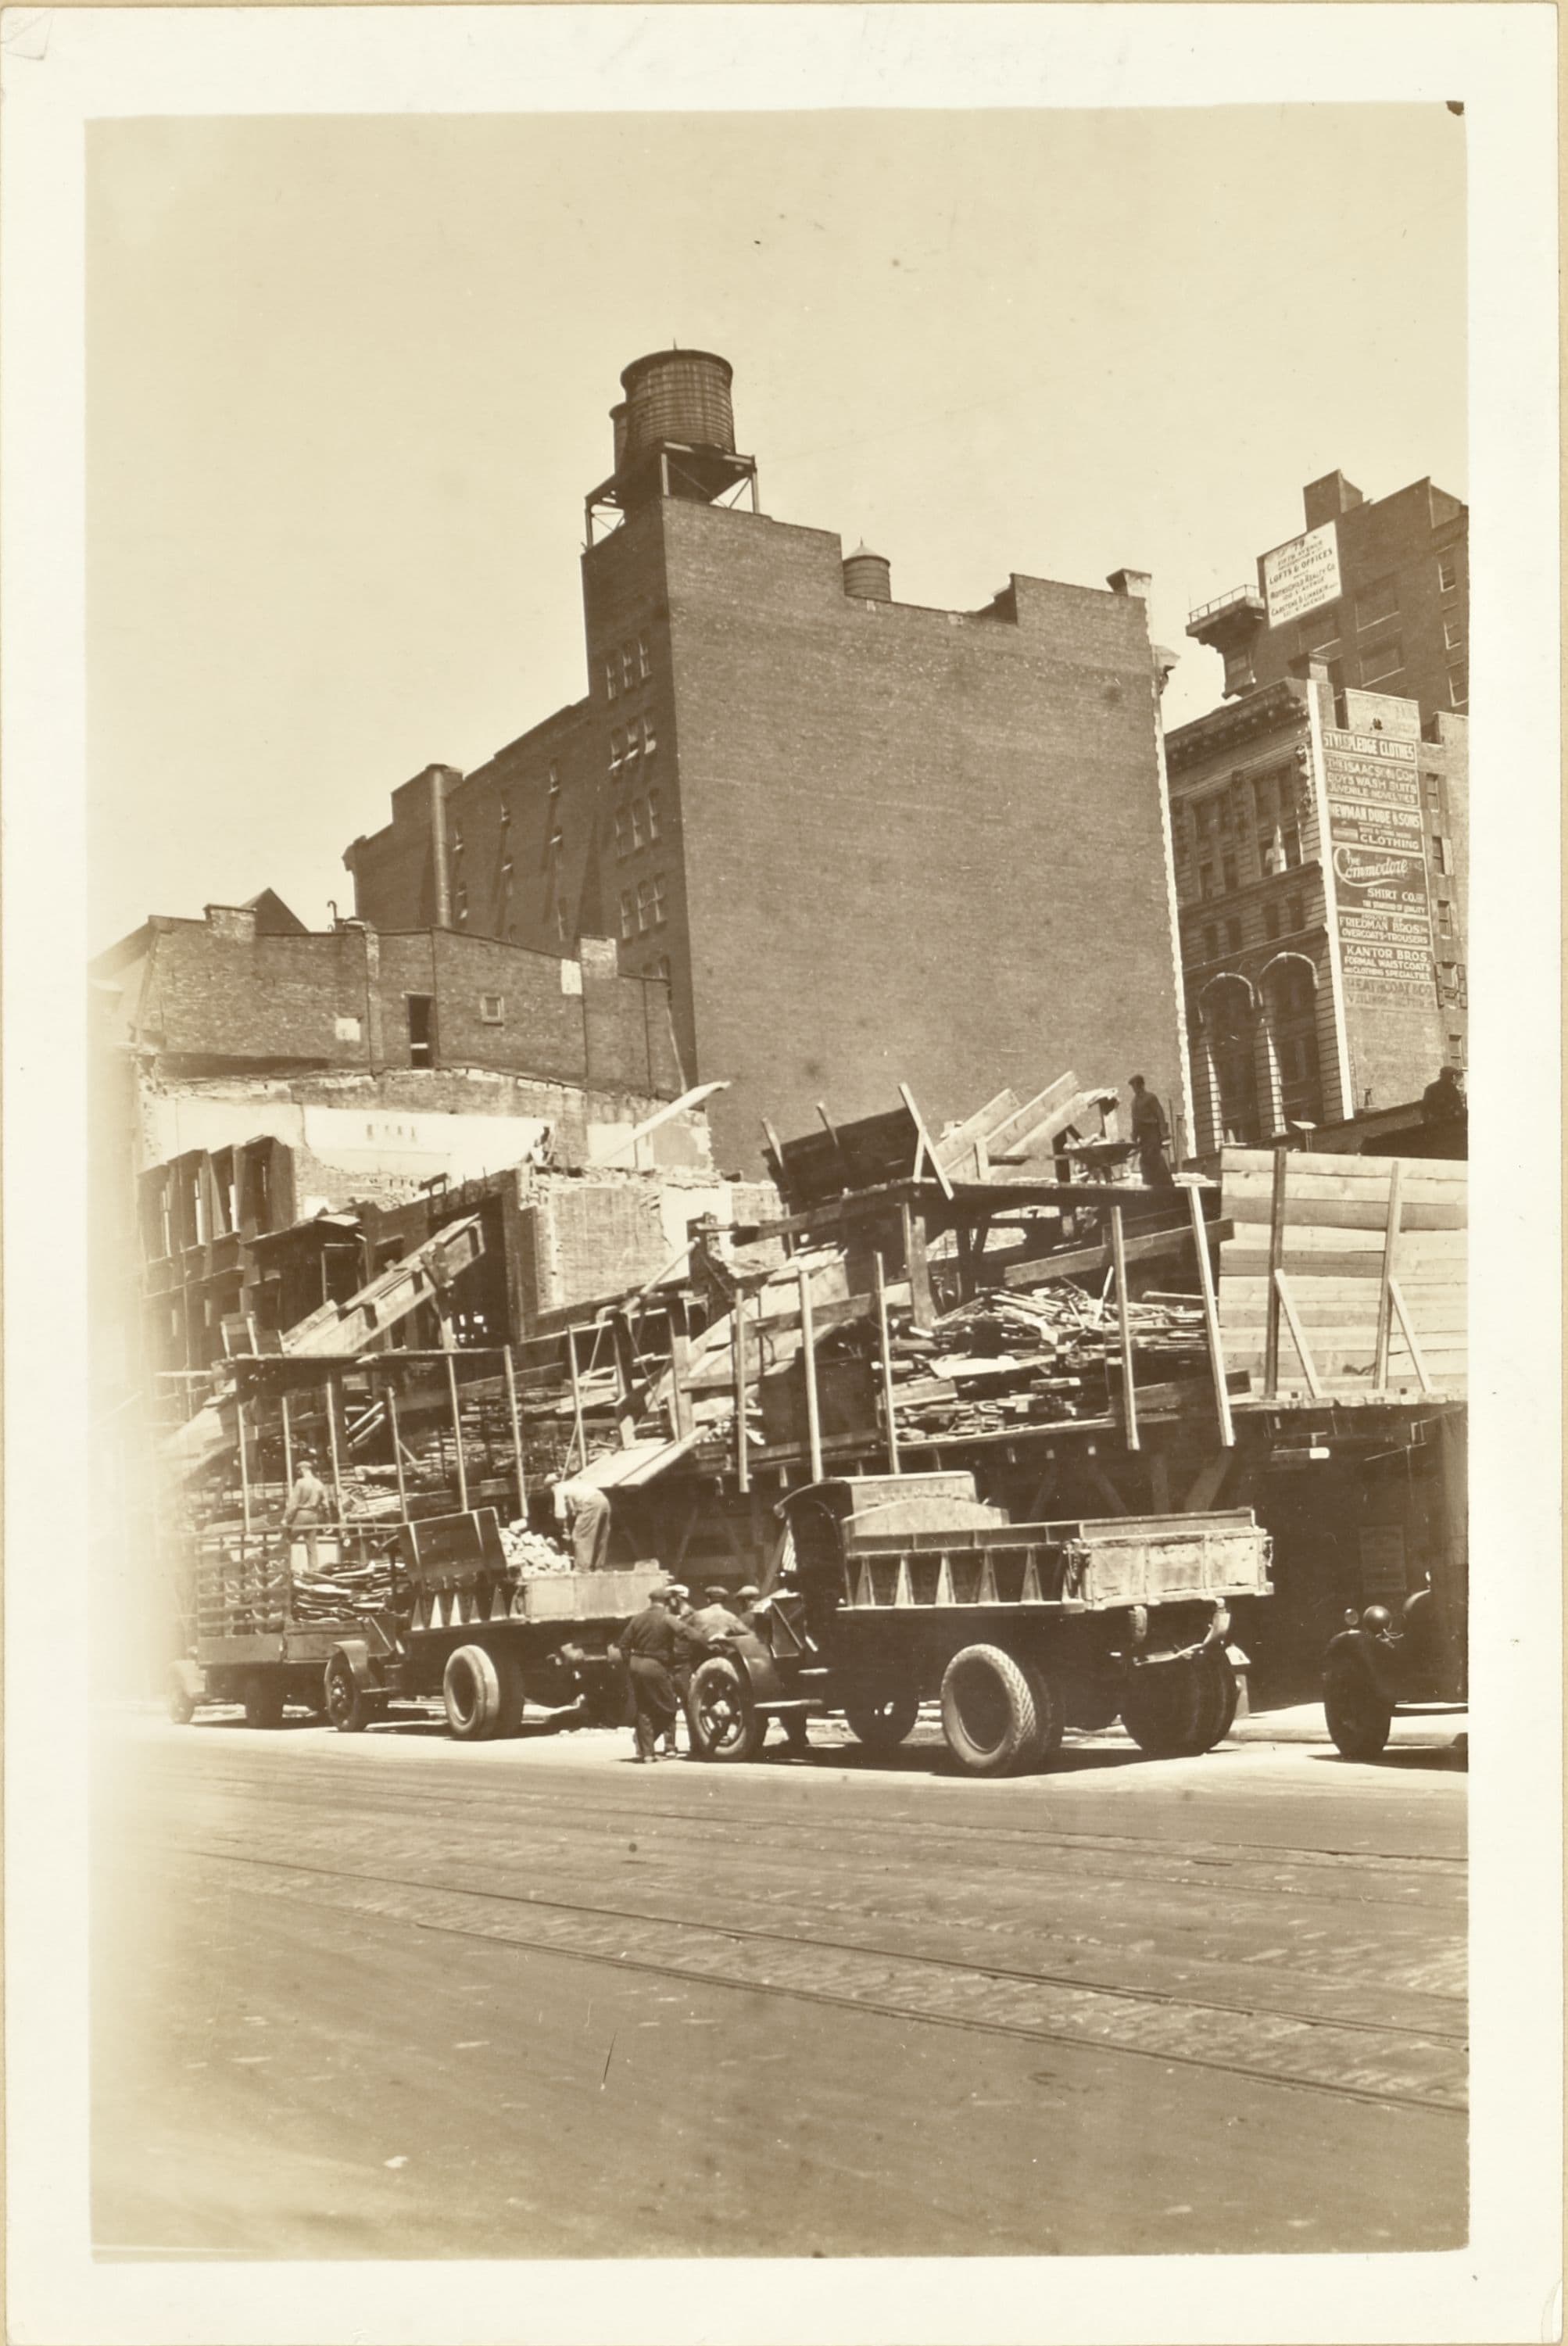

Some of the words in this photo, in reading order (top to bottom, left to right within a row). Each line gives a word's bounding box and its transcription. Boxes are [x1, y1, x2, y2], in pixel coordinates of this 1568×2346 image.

[1298, 539, 1323, 556] AVENUE
[1269, 568, 1292, 585] LOFTS
[1301, 548, 1333, 569] OFFICES
[1379, 740, 1415, 761] CLOTHES
[1327, 772, 1355, 786] BOYS
[1355, 775, 1387, 790] WASH
[1389, 780, 1417, 795] SUITS
[1328, 783, 1369, 797] JUVENILE
[1370, 790, 1416, 804] NOVELTIES
[1398, 811, 1420, 828] SONS
[1360, 833, 1419, 851] CLOTHING
[1334, 847, 1408, 885] Commodore
[1367, 887, 1397, 901] SHIRT
[1403, 904, 1426, 914] QUALITY
[1339, 915, 1388, 931] FRIEDMAN
[1346, 944, 1393, 959] KANTOR
[1344, 956, 1376, 968] FORMAL
[1376, 958, 1432, 972] WAISTCOATS
[1353, 966, 1384, 976] CLOTHING
[1384, 969, 1431, 980] SPECIALTIES
